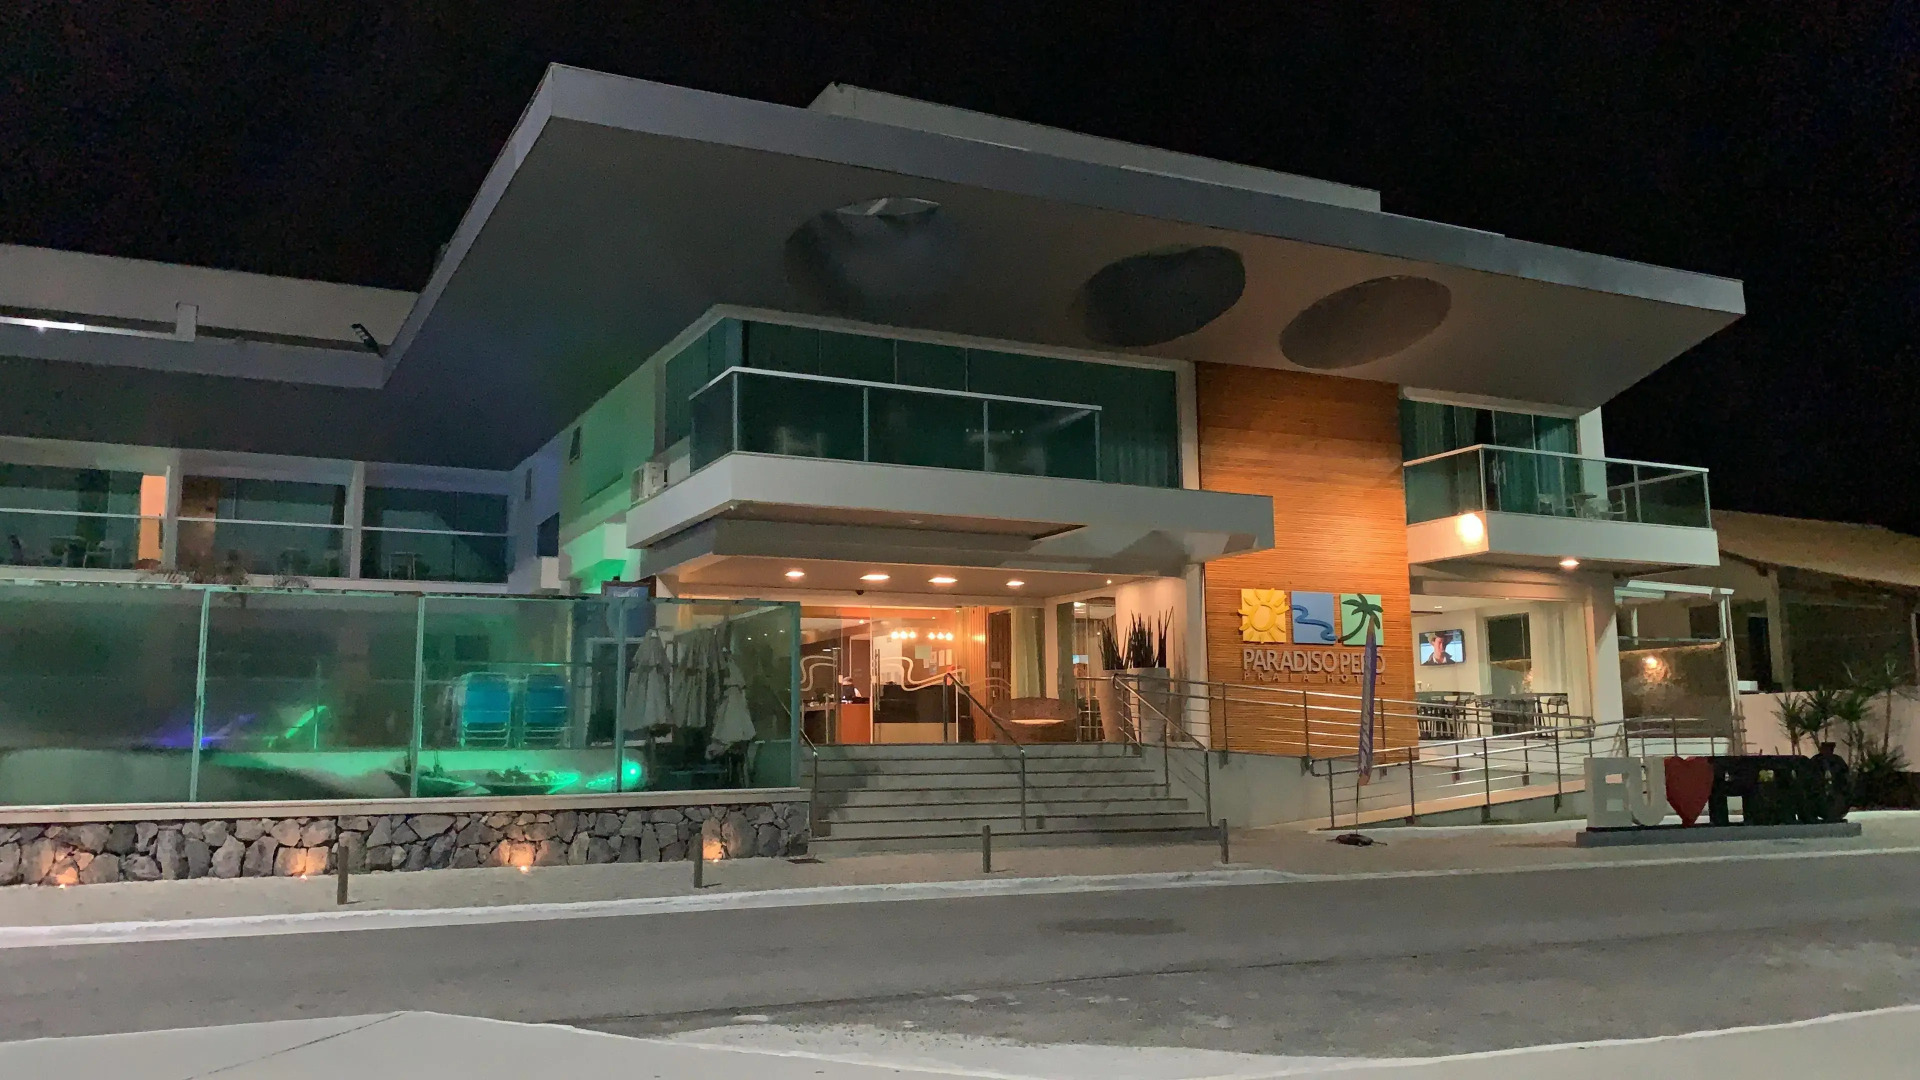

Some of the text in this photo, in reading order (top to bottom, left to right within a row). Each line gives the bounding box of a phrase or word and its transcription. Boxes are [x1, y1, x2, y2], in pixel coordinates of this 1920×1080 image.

[1243, 647, 1386, 674] PARADISO PEÓ
[1243, 671, 1386, 685] PRAIA HOTL
[1583, 756, 1667, 828] EU
